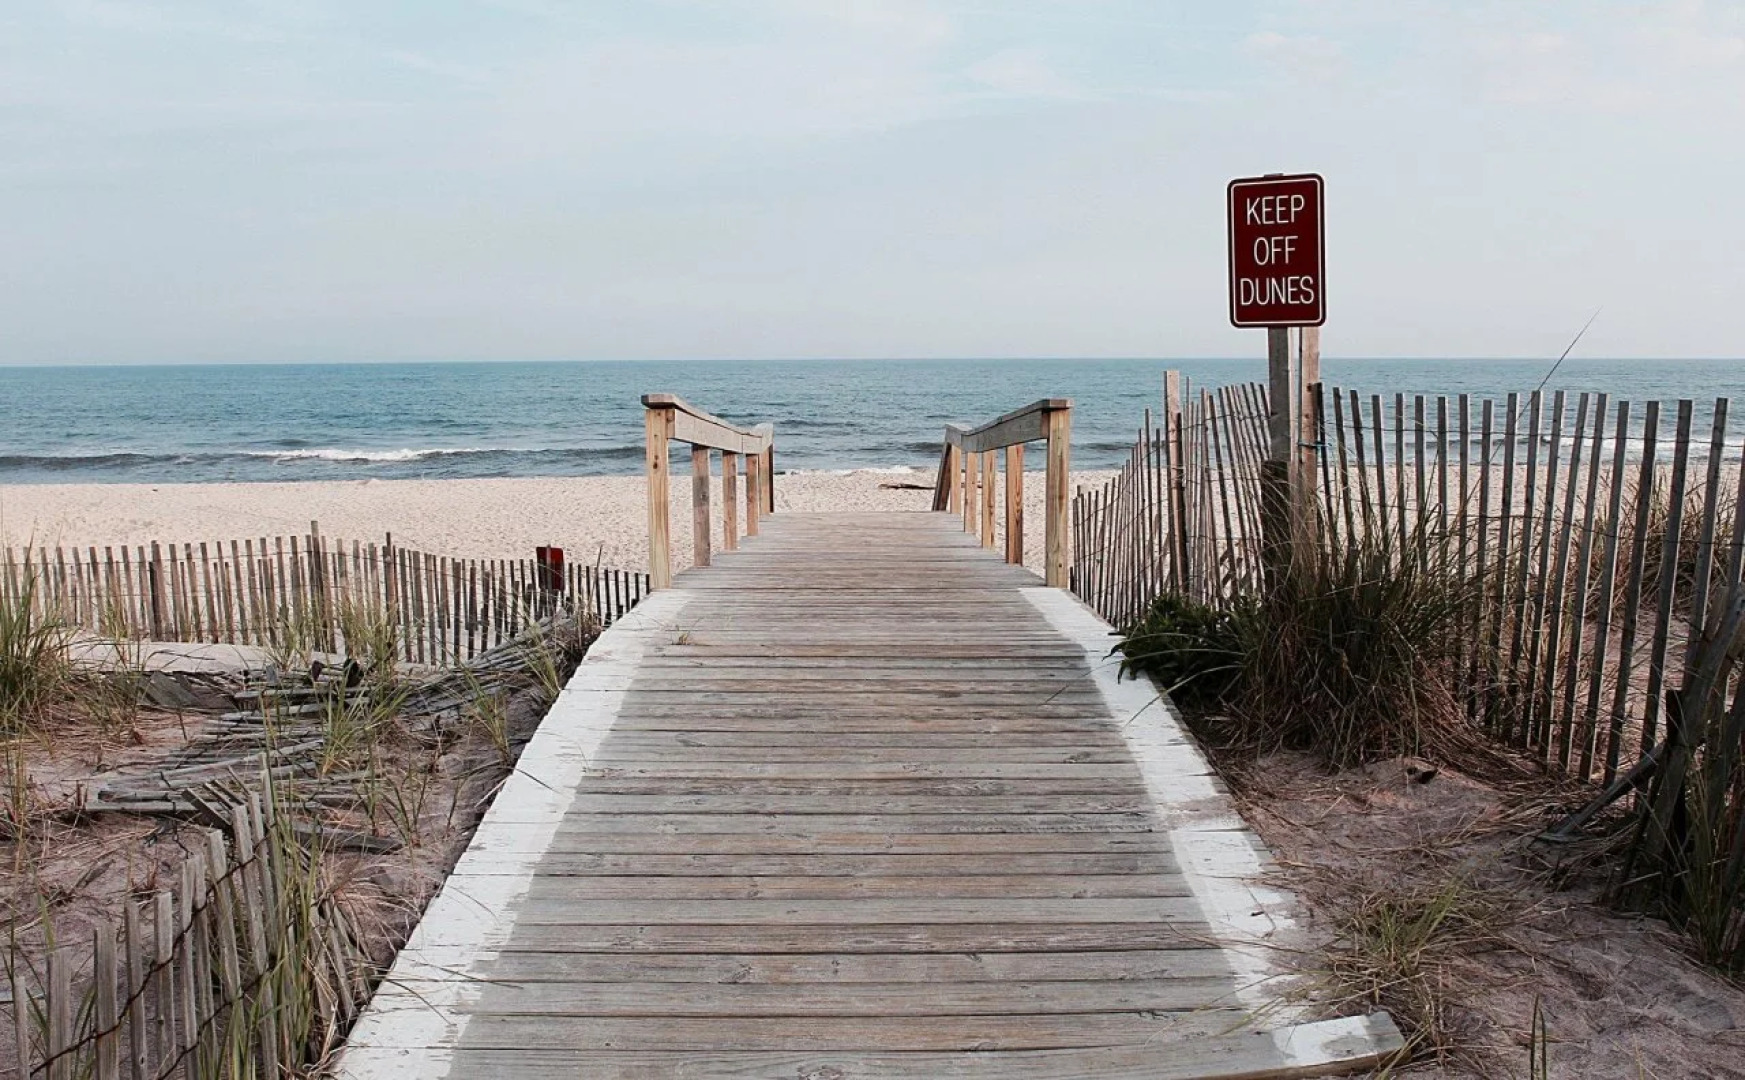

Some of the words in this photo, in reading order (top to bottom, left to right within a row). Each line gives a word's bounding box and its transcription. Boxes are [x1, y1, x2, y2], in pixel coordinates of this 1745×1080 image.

[1246, 195, 1305, 225] KEEP
[1253, 236, 1299, 265] OFF
[1240, 275, 1315, 306] DUNES
